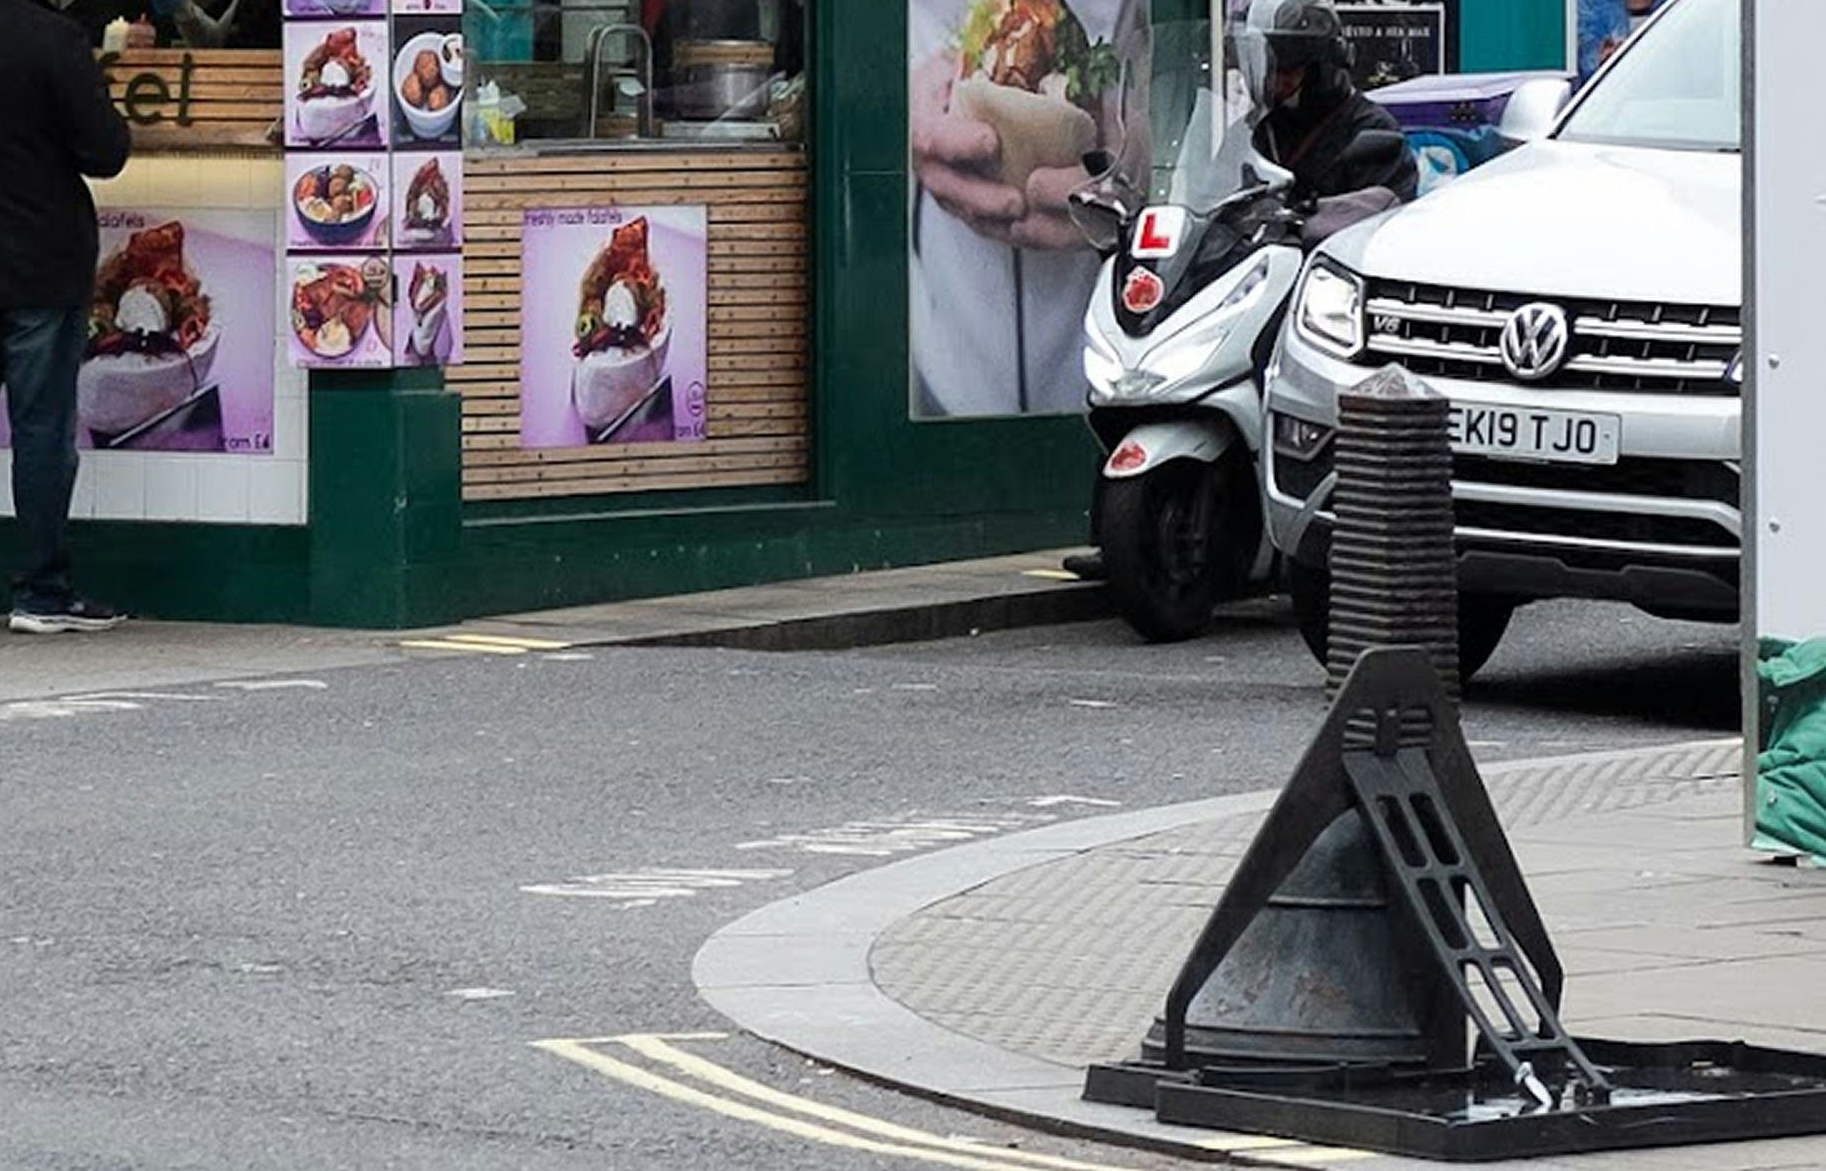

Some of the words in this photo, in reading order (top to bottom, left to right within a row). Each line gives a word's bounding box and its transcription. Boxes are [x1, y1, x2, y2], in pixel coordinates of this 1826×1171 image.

[1139, 213, 1171, 249] L
[1449, 406, 1519, 448] EK19
[1530, 415, 1597, 455] TJO
